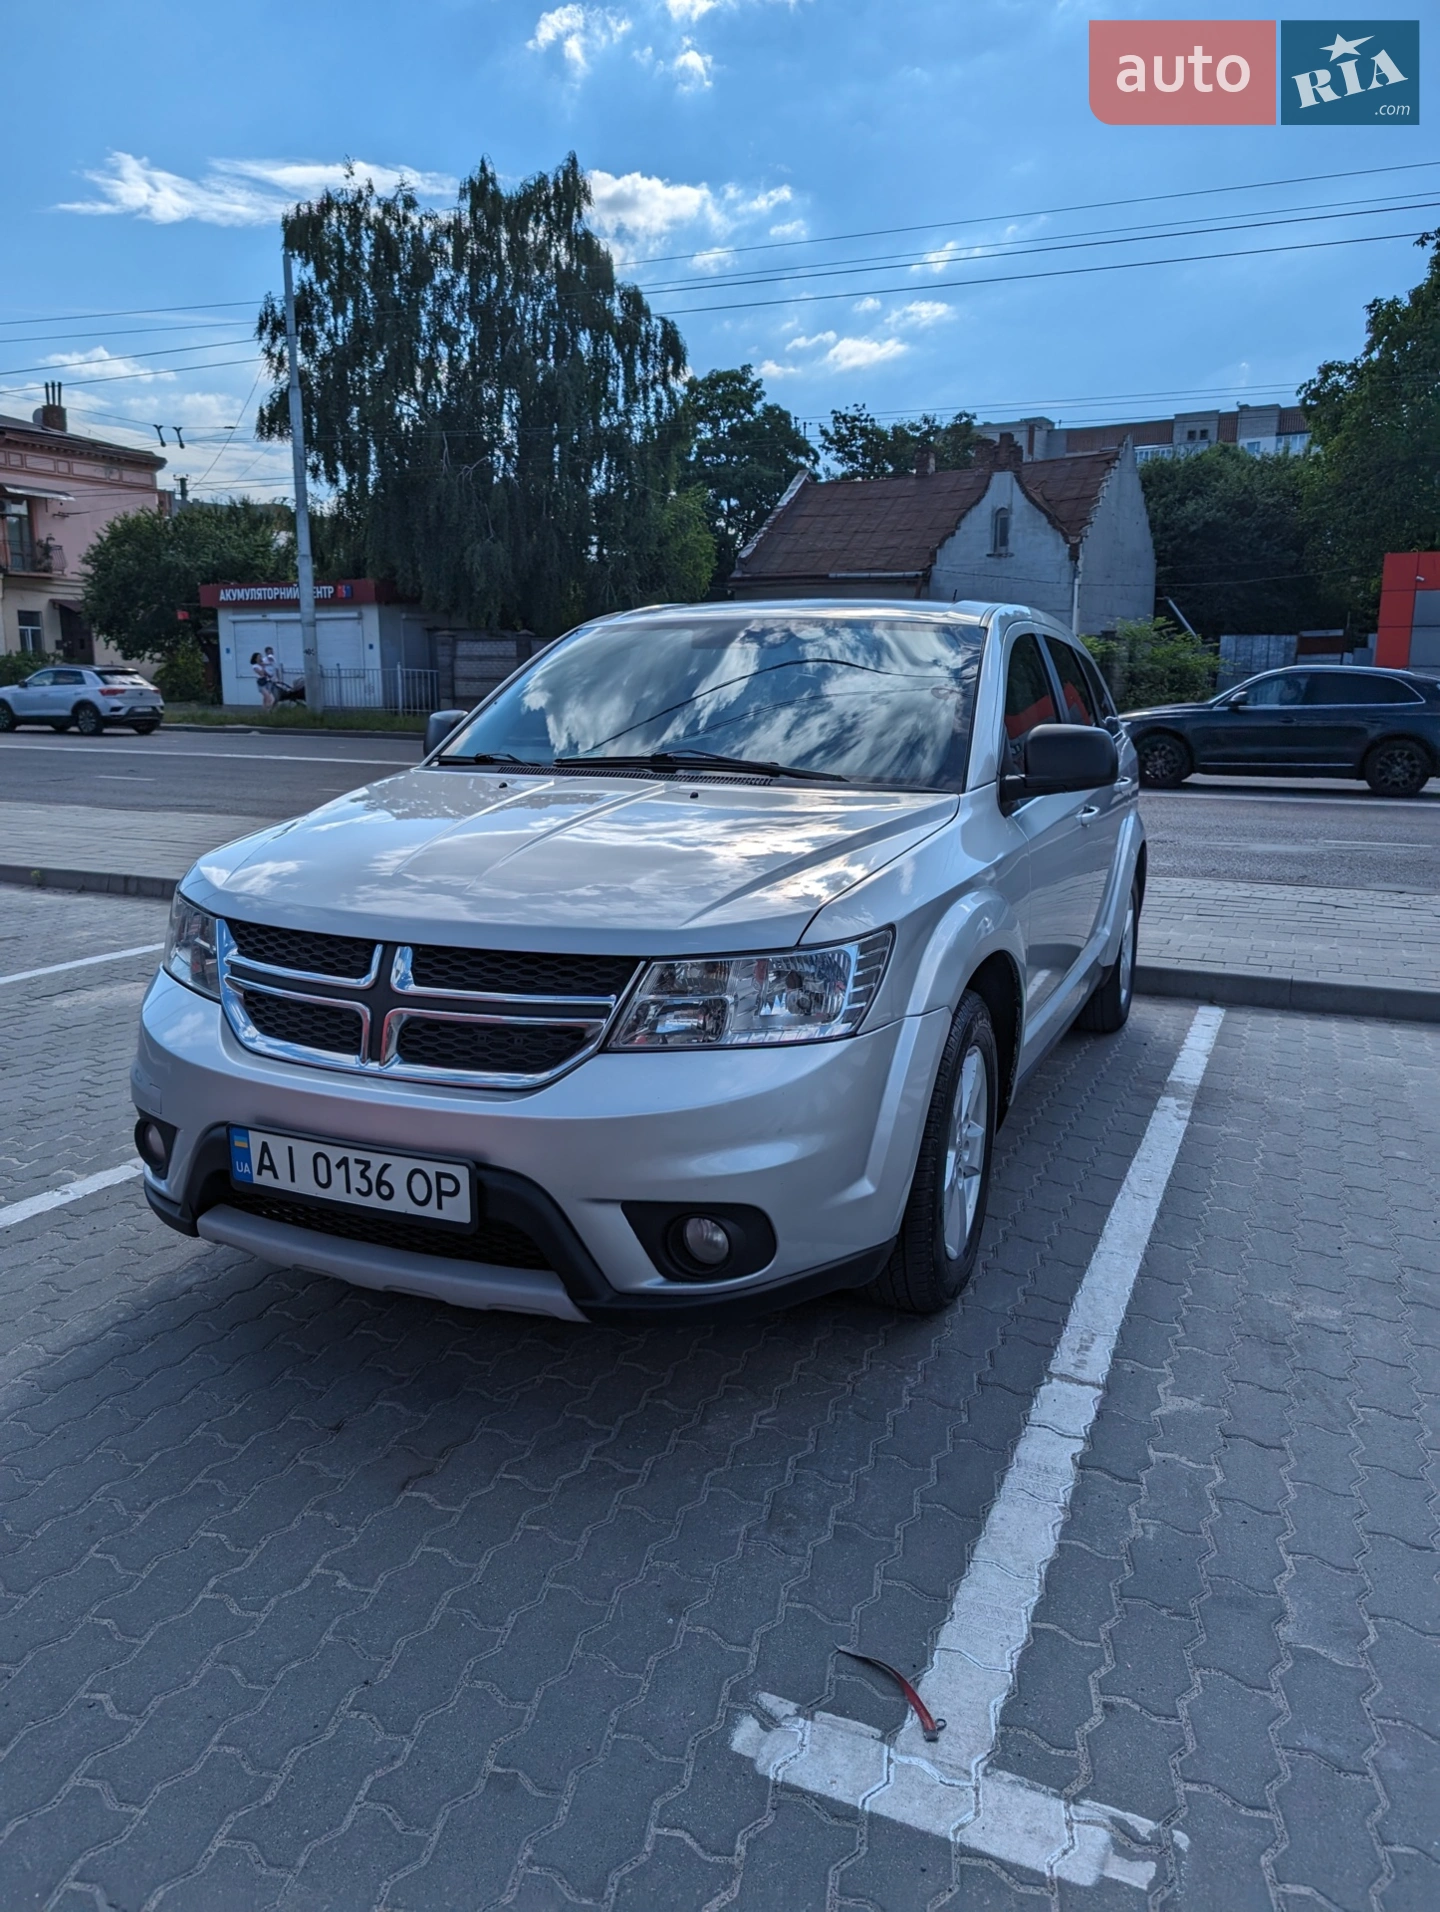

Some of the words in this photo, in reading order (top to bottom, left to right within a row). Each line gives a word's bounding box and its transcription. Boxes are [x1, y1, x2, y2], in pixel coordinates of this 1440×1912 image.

[219, 583, 300, 602] АКУМУЛЯТОРНИЙ
[311, 585, 335, 600] ЕНТР
[236, 1160, 251, 1175] UA
[312, 1151, 395, 1201] 0136
[406, 1167, 461, 1211] OP
